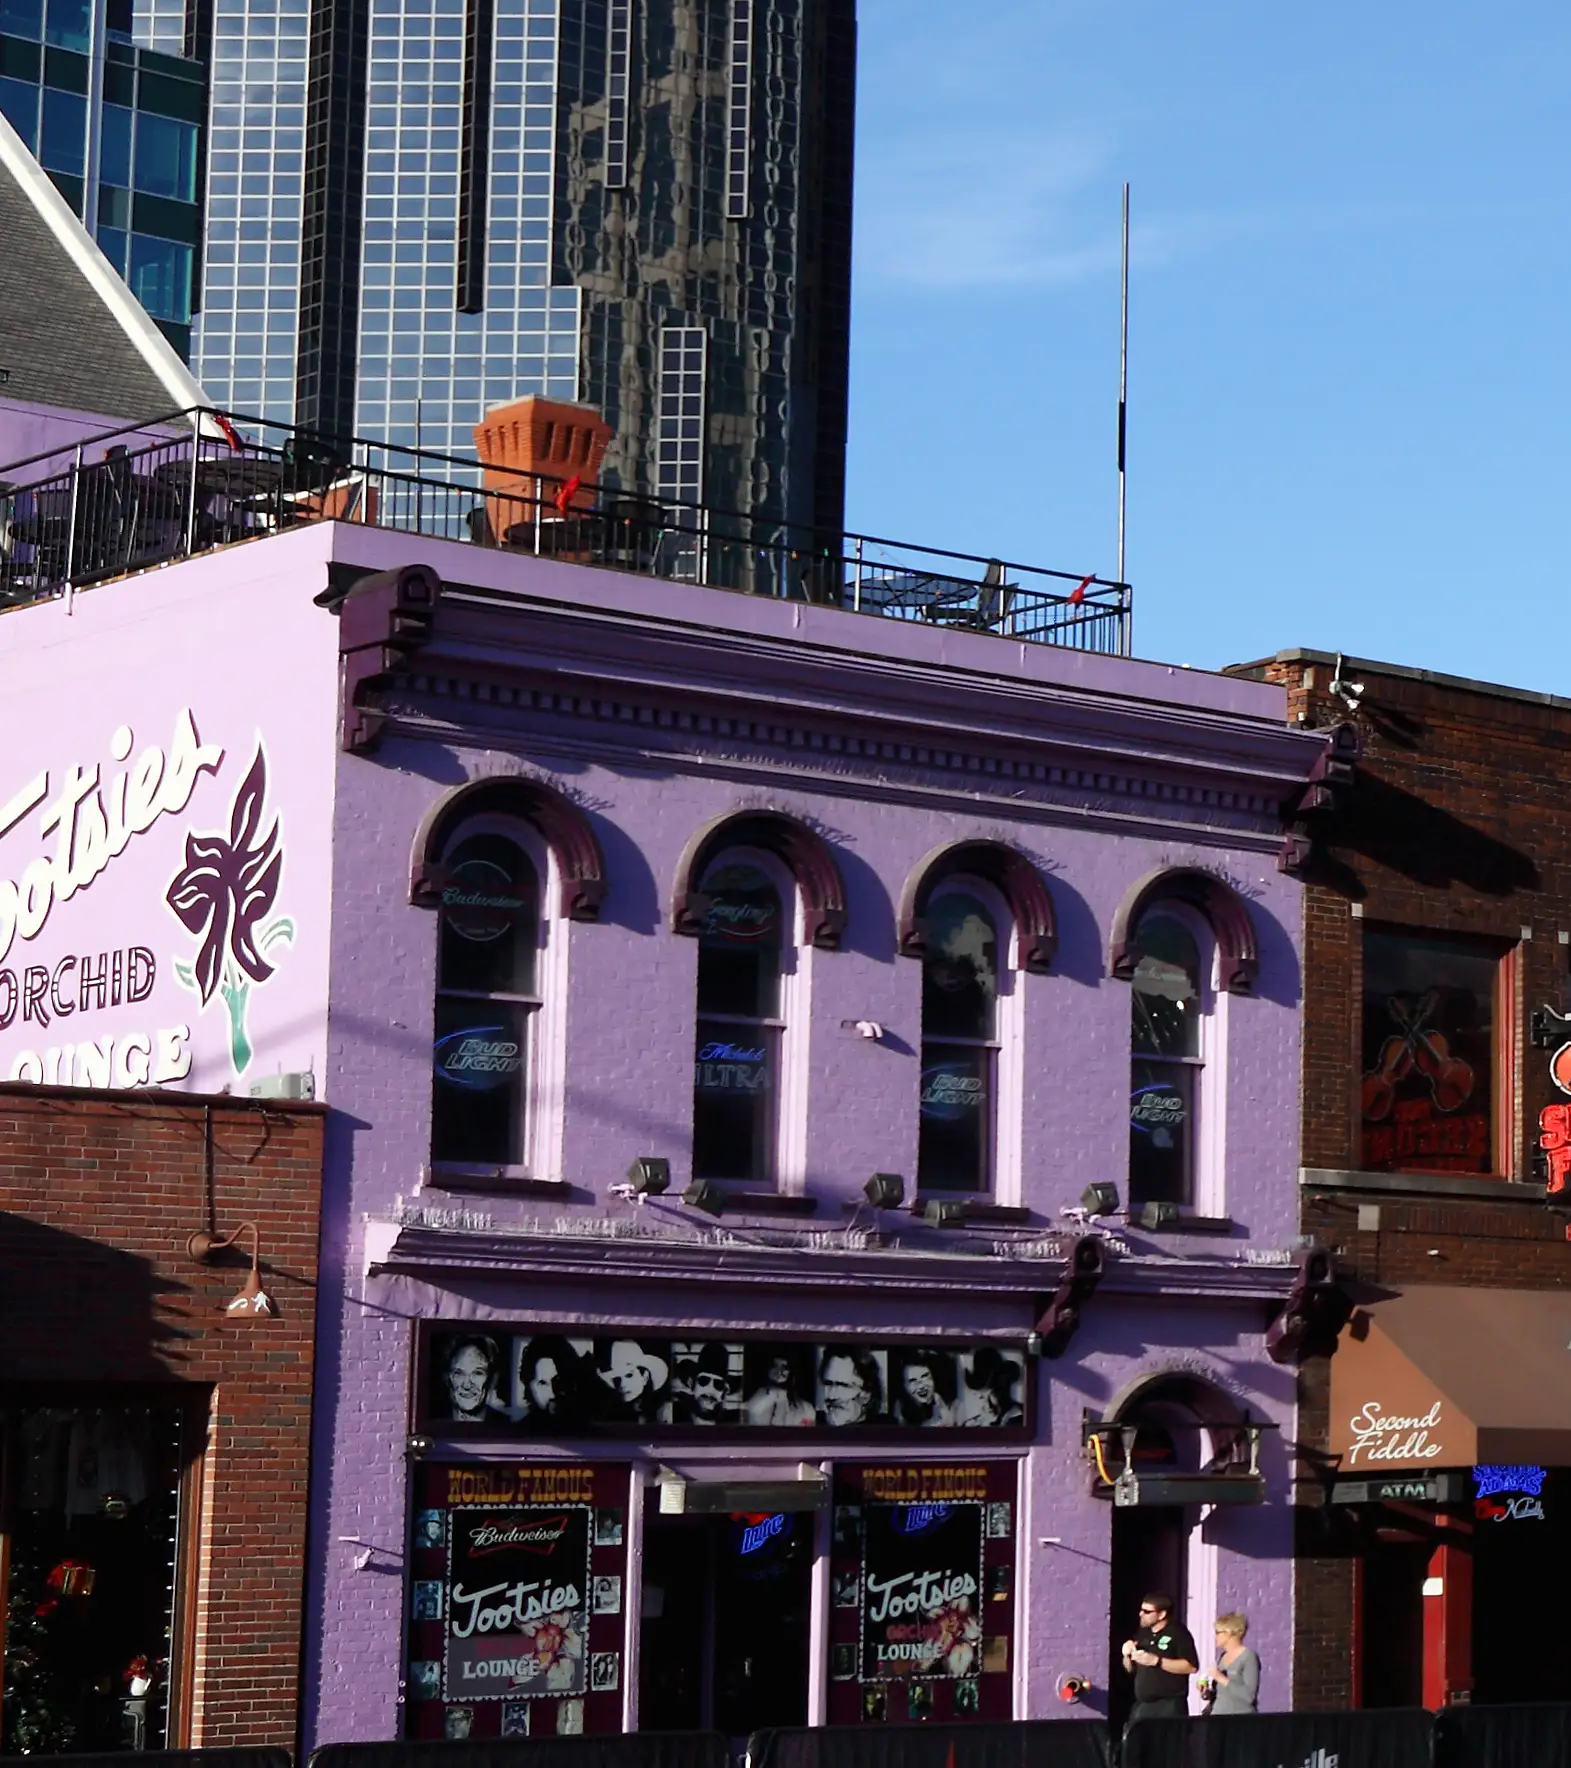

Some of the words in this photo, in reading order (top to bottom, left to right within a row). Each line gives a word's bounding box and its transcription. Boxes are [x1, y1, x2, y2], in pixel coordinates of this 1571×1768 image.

[1350, 1401, 1443, 1435] Second
[1349, 1430, 1443, 1465] Fiddle
[1379, 1483, 1426, 1499] ATM
[469, 1526, 565, 1547] Budweiser
[452, 1578, 581, 1639] Tootsies
[867, 1570, 978, 1623] Tootsies
[461, 1658, 542, 1680] LOUNGE
